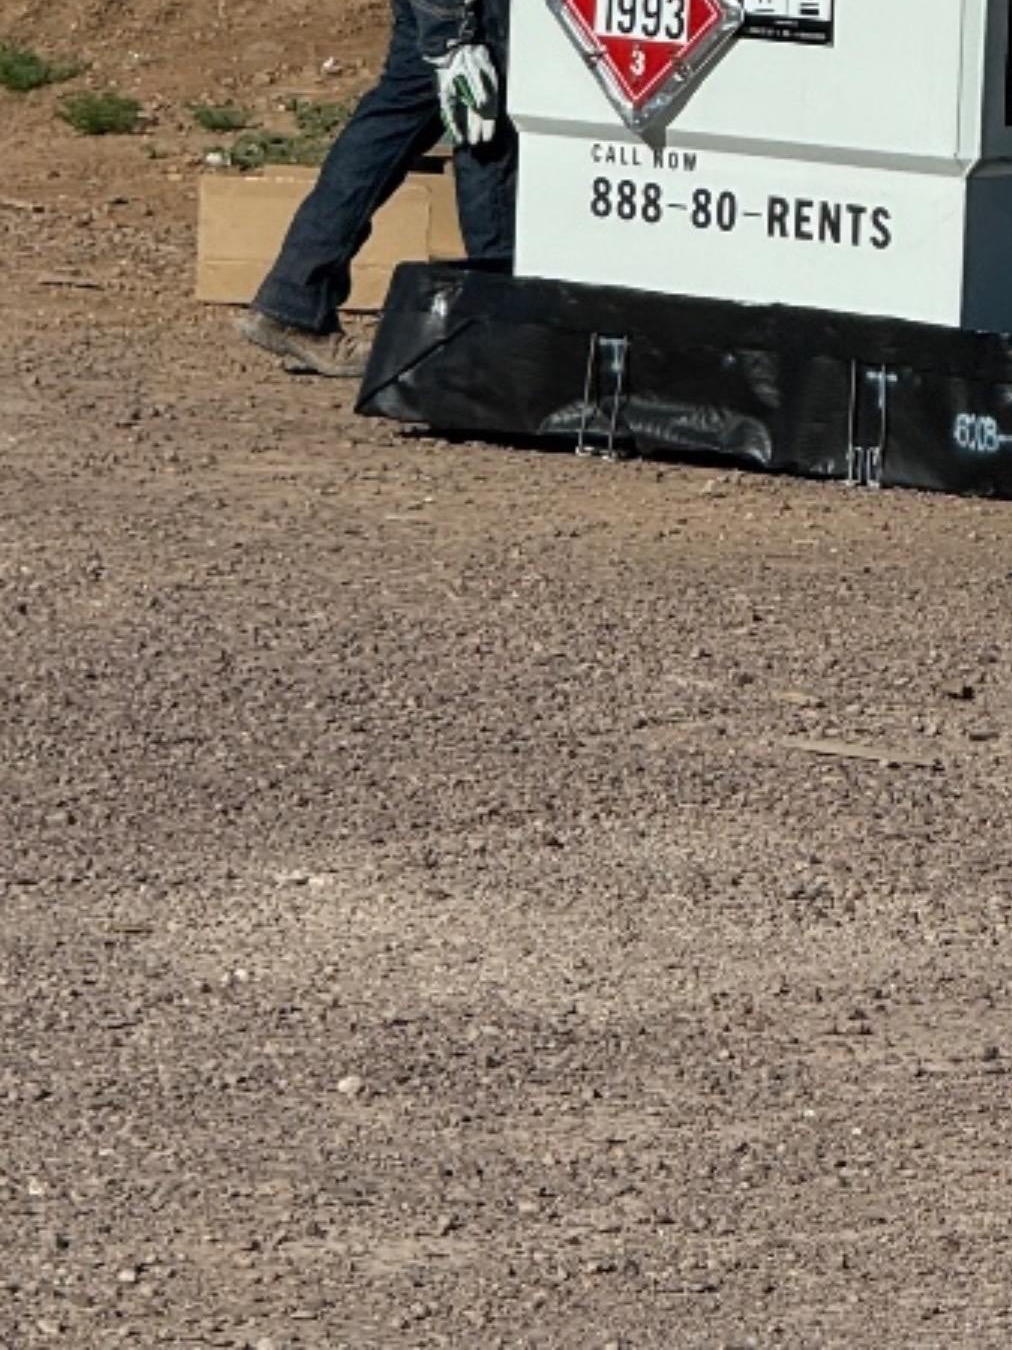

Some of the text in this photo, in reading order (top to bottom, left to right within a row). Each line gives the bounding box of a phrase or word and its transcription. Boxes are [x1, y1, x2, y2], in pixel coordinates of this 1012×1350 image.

[629, 48, 647, 77] 3
[591, 143, 698, 172] CALL NOW
[590, 176, 892, 250] 888-80-RENTS
